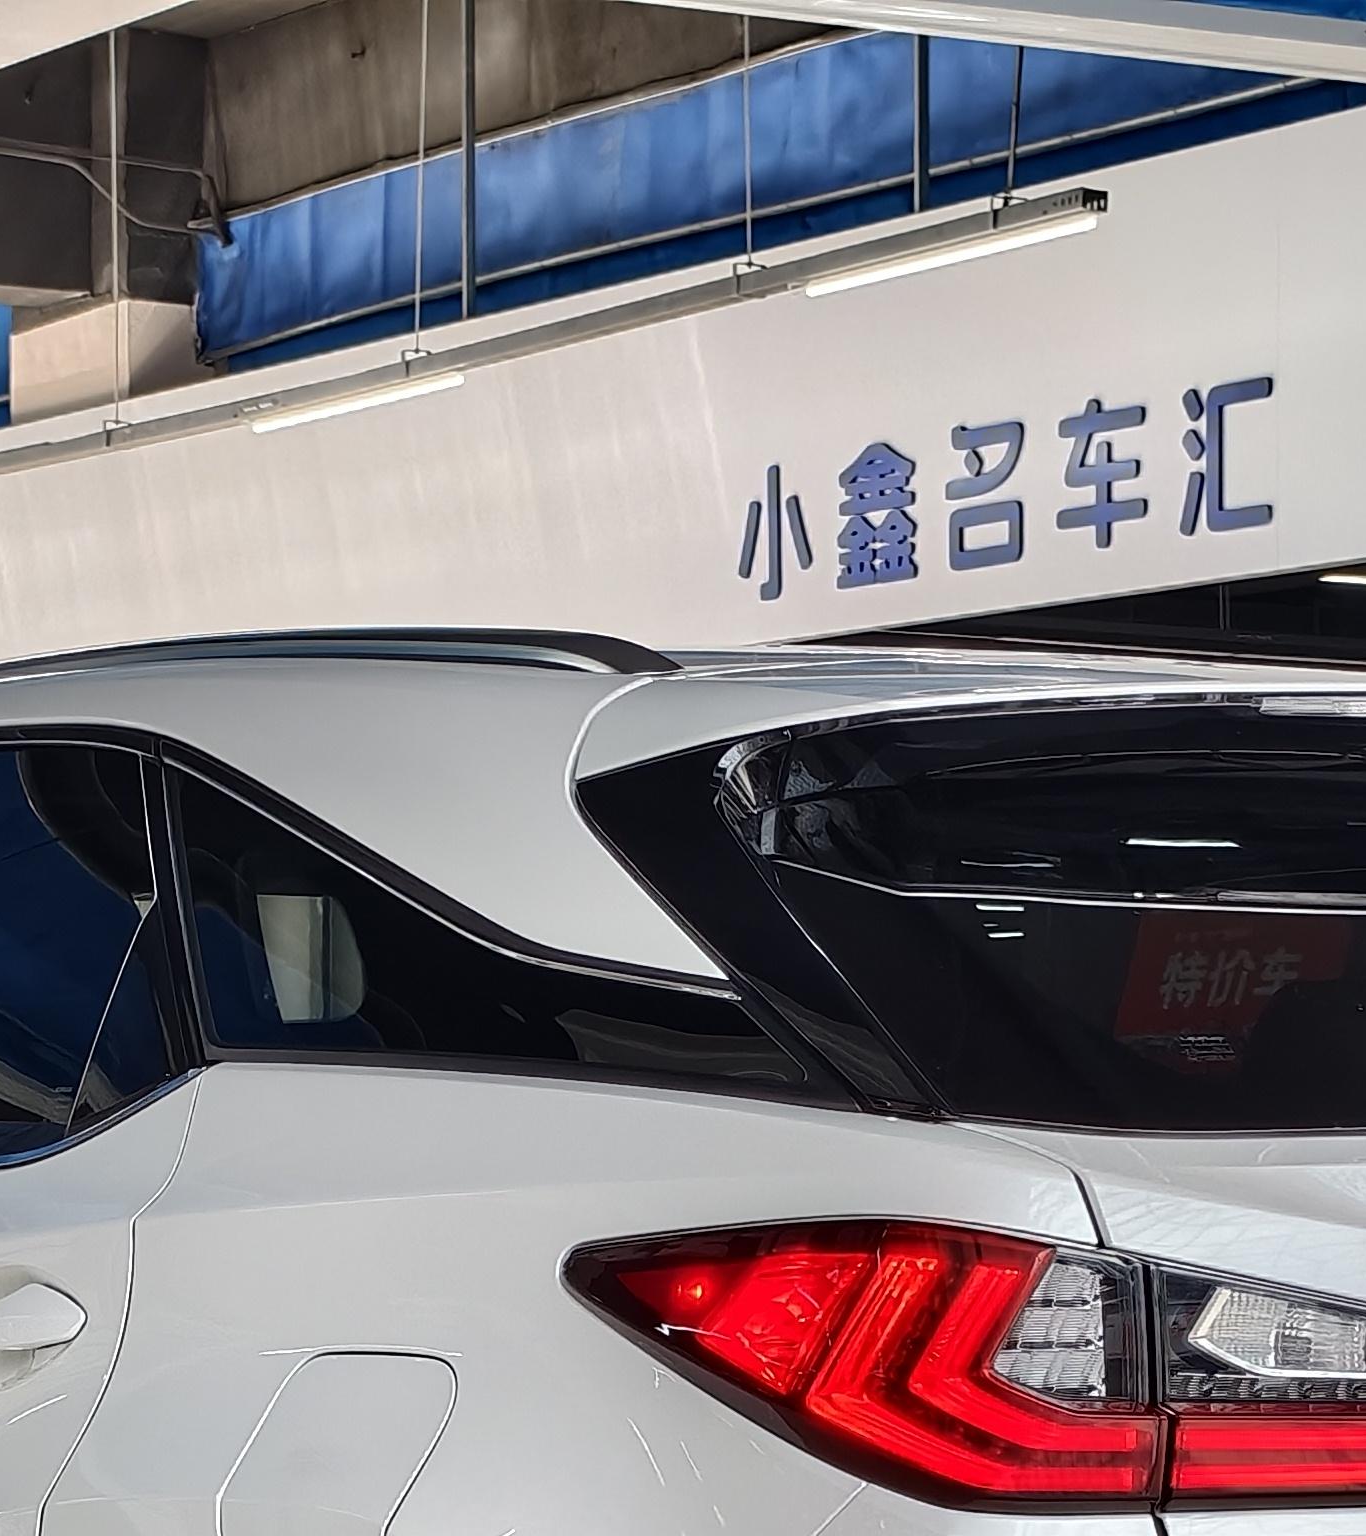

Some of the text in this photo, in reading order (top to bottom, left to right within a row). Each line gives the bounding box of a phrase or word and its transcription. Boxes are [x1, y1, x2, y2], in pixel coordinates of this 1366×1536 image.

[737, 376, 1275, 602] 小鑫名车汇
